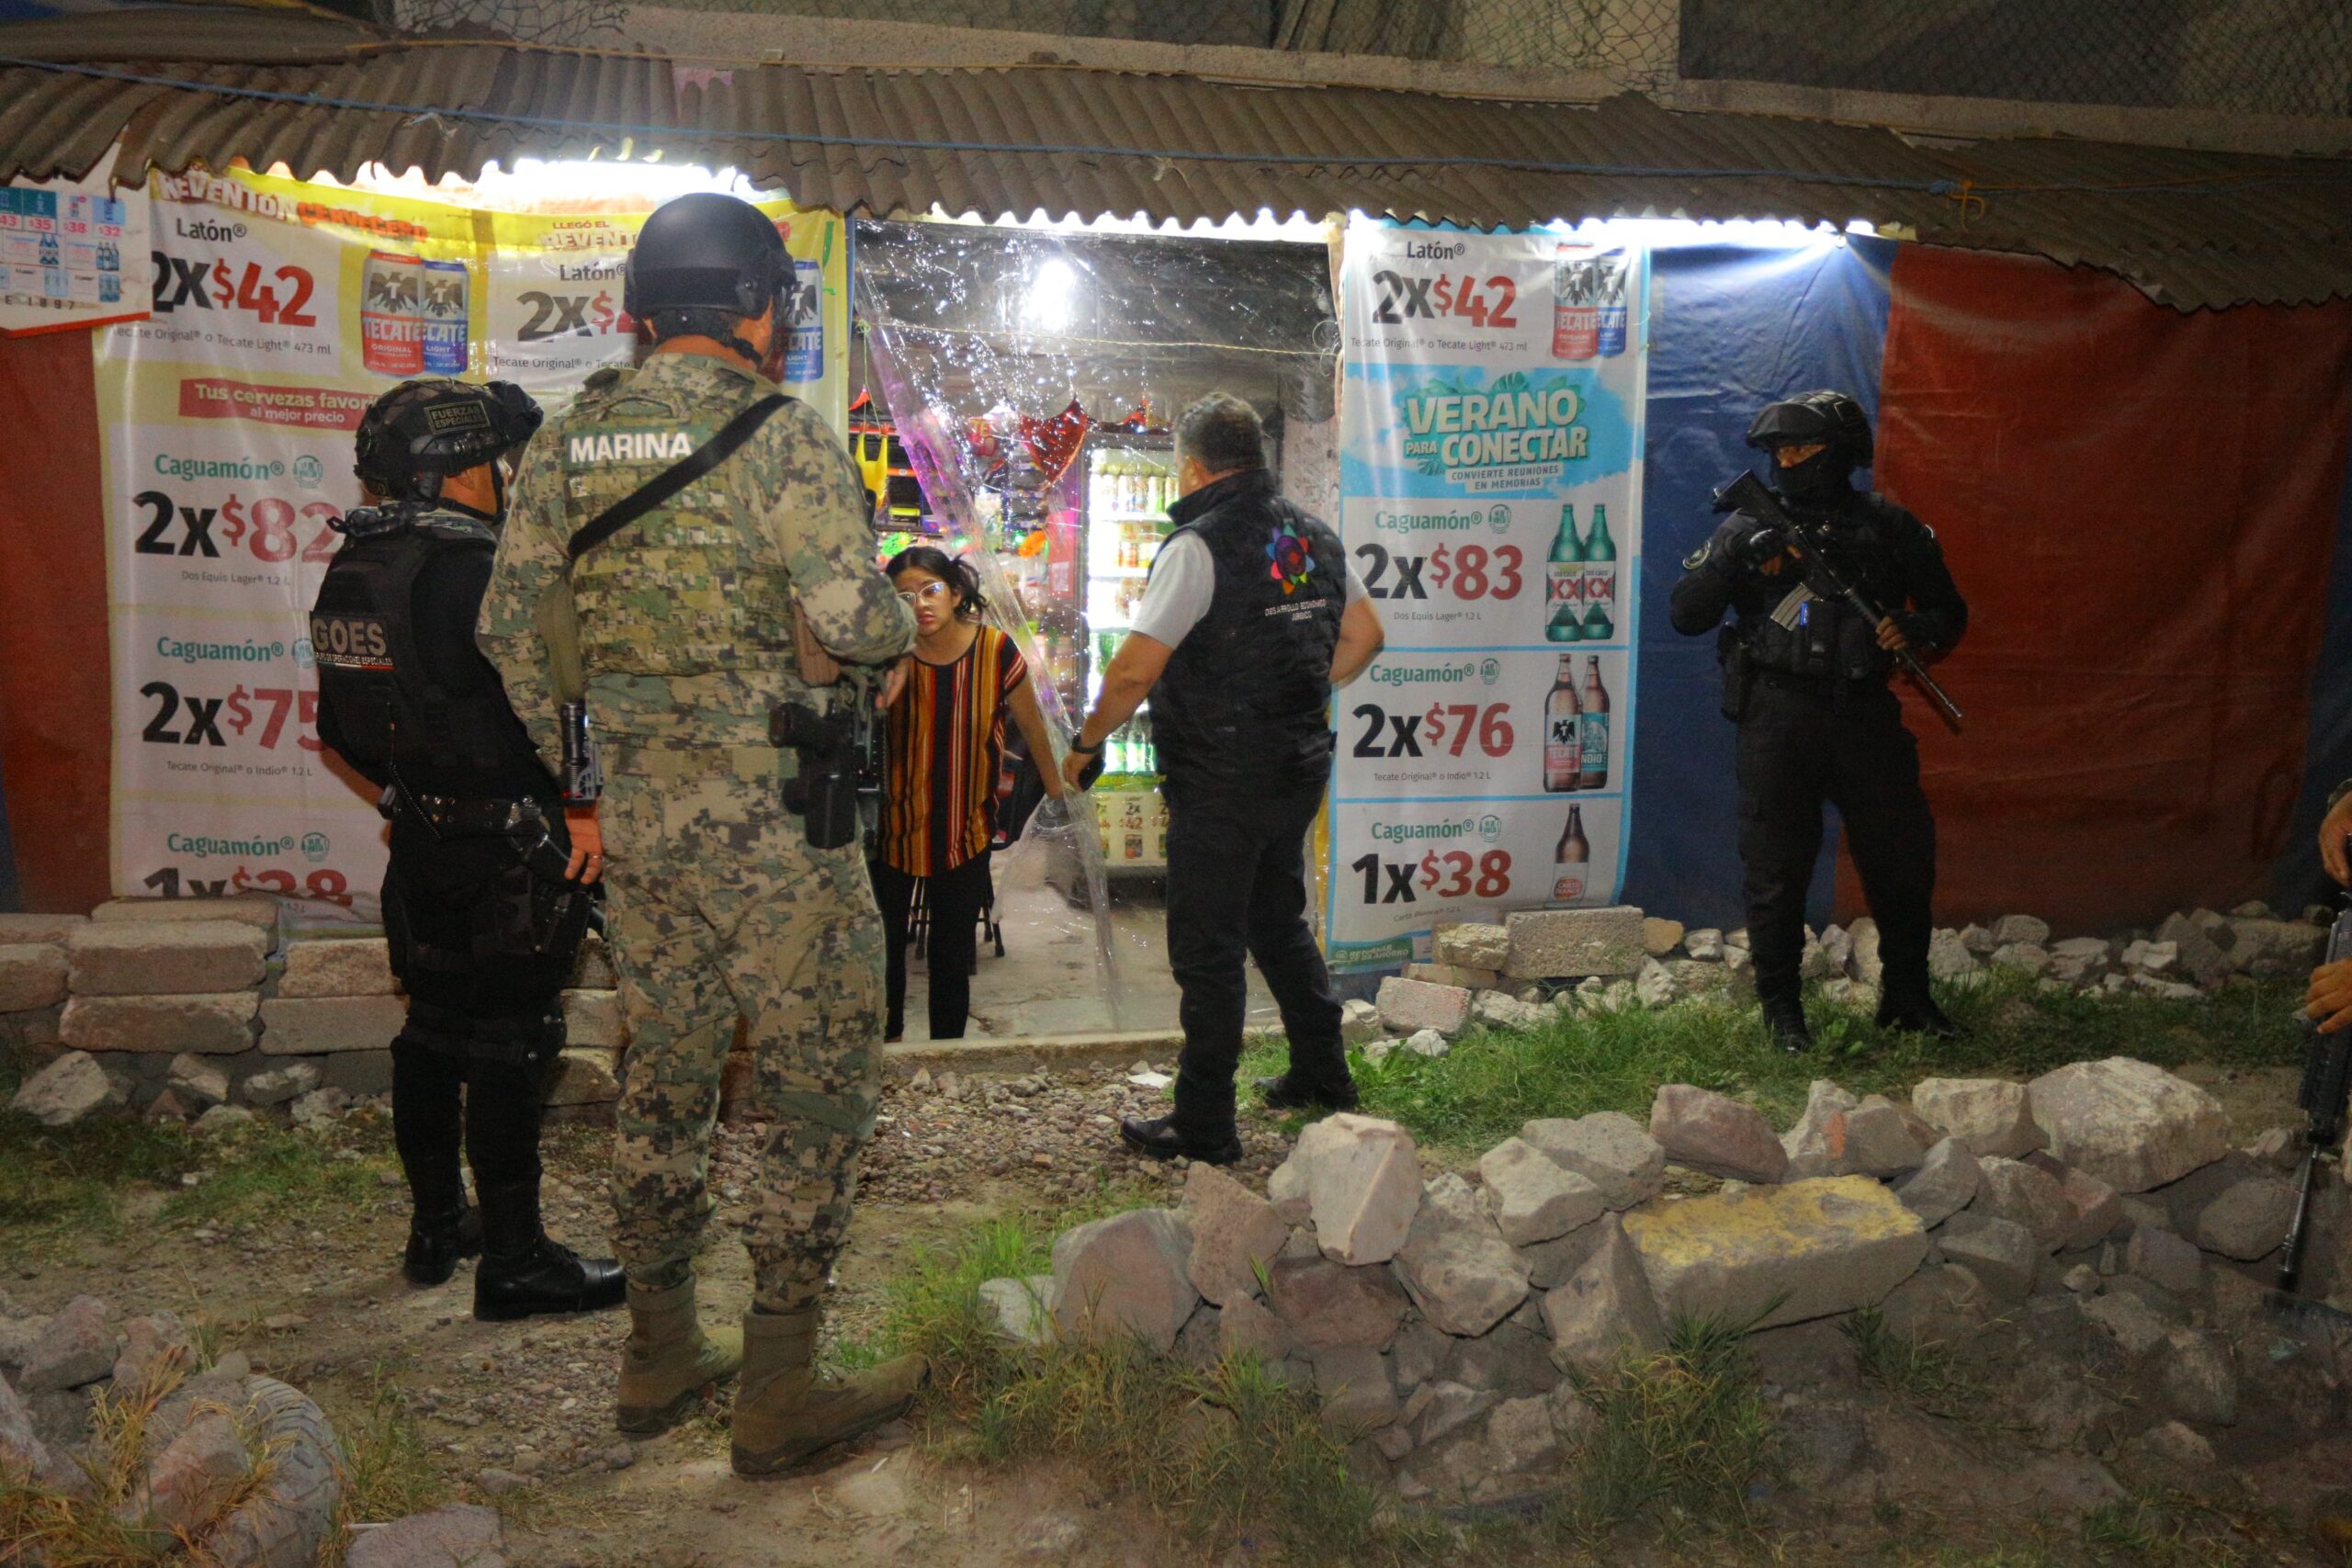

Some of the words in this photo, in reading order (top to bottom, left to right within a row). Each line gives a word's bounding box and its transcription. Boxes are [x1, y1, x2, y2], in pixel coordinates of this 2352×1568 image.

[553, 220, 593, 230] LLEGÓ
[363, 317, 421, 342] TECATE
[205, 333, 212, 343] o
[217, 334, 254, 349] Tecate
[294, 344, 313, 354] 473
[317, 344, 331, 355] ml
[371, 344, 413, 354] ORIGINAL
[1437, 339, 1466, 349] Tecate
[1499, 343, 1513, 351] 473
[1517, 342, 1527, 351] ml
[493, 356, 529, 367] Tecate
[194, 383, 229, 400] Tus
[233, 389, 315, 408] cervezas
[250, 407, 262, 418] al
[265, 409, 301, 422] mejor
[304, 411, 345, 423] precio
[432, 405, 481, 420] FUERZAS
[1408, 389, 1578, 434] VERANO
[435, 416, 486, 428] ESPECIALES
[571, 433, 693, 463] MARINA
[1406, 441, 1438, 455] PARA
[1442, 426, 1589, 467] CONECTAR
[1452, 468, 1505, 481] CONVIERTE
[1508, 465, 1559, 477] REUNIONES
[1475, 481, 1487, 490] EN
[1491, 478, 1541, 489] MEMORIAS
[181, 570, 199, 581] Dos
[201, 572, 228, 584] Equis
[1394, 612, 1409, 620] Dos
[1411, 612, 1434, 622] Equis
[311, 617, 387, 656] GOES
[1581, 753, 1602, 764] NDIO
[166, 761, 198, 772] Tecate
